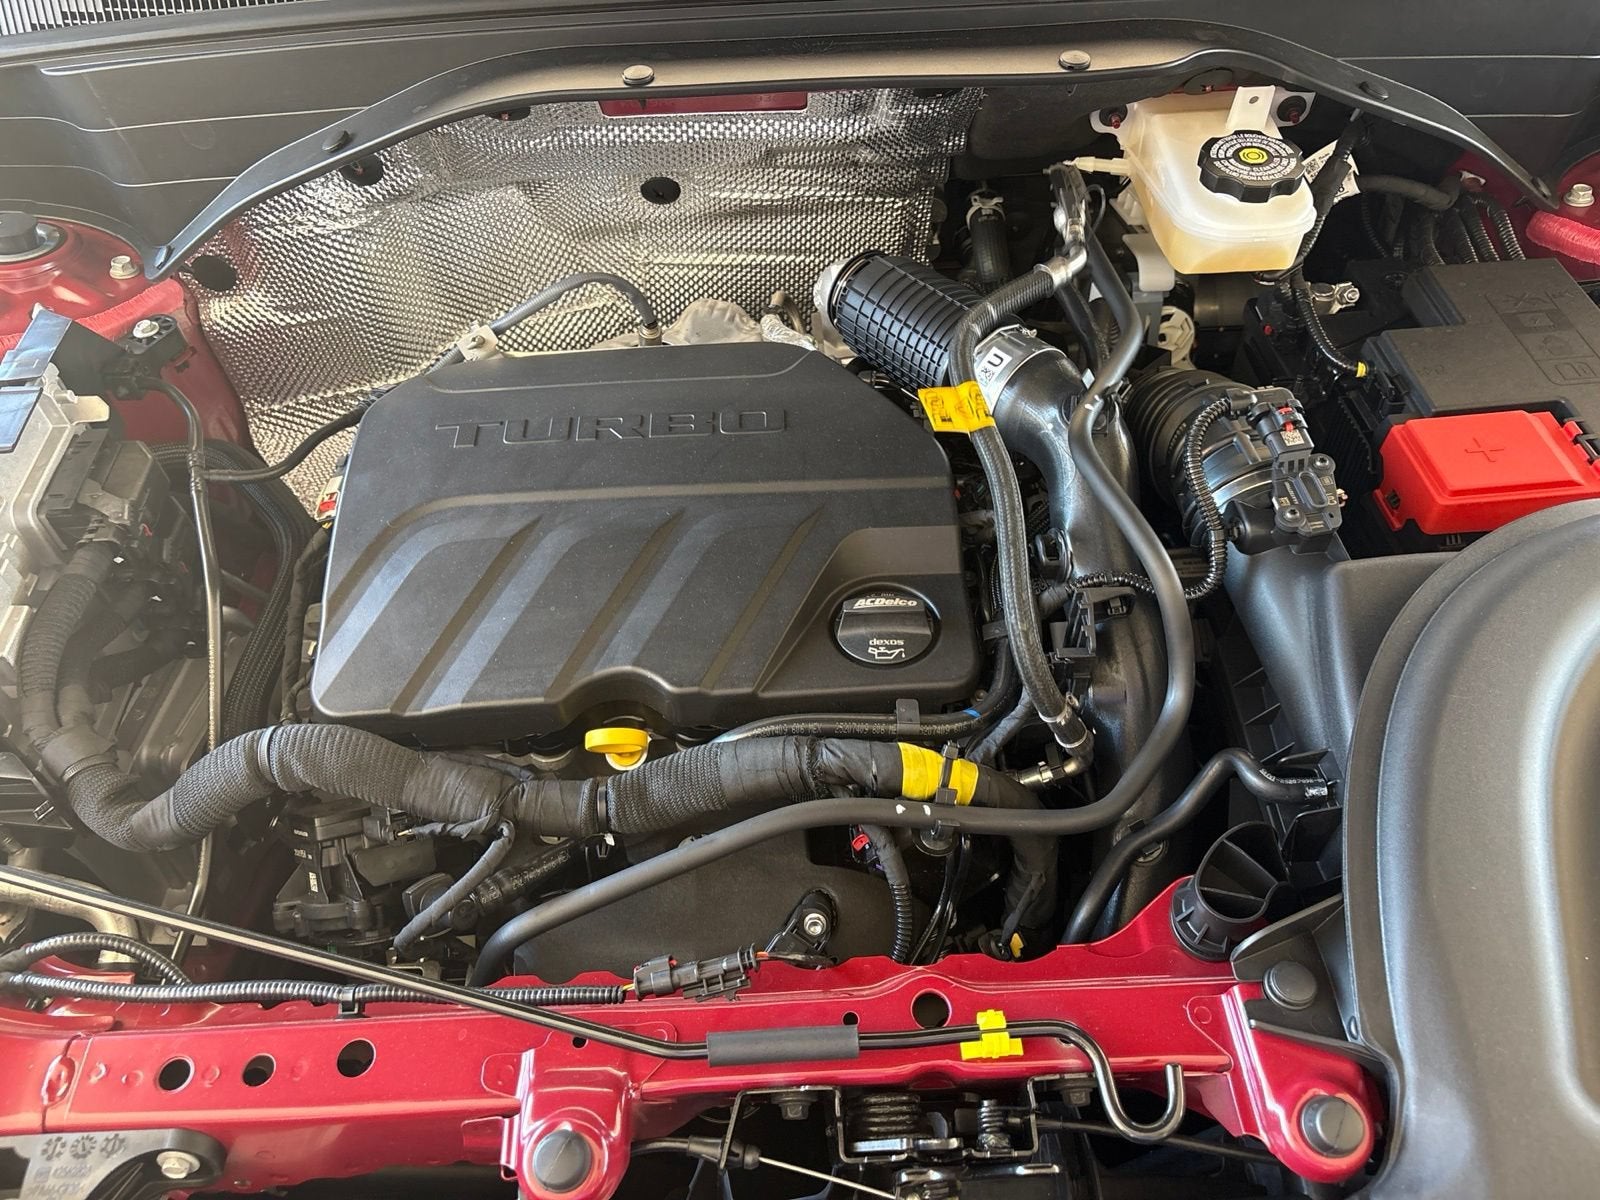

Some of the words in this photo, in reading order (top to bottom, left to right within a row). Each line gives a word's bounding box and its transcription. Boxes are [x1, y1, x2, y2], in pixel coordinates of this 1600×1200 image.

[987, 353, 1004, 367] U
[435, 409, 786, 448] TURBO
[853, 598, 918, 609] ACDelco
[869, 638, 905, 646] dexos
